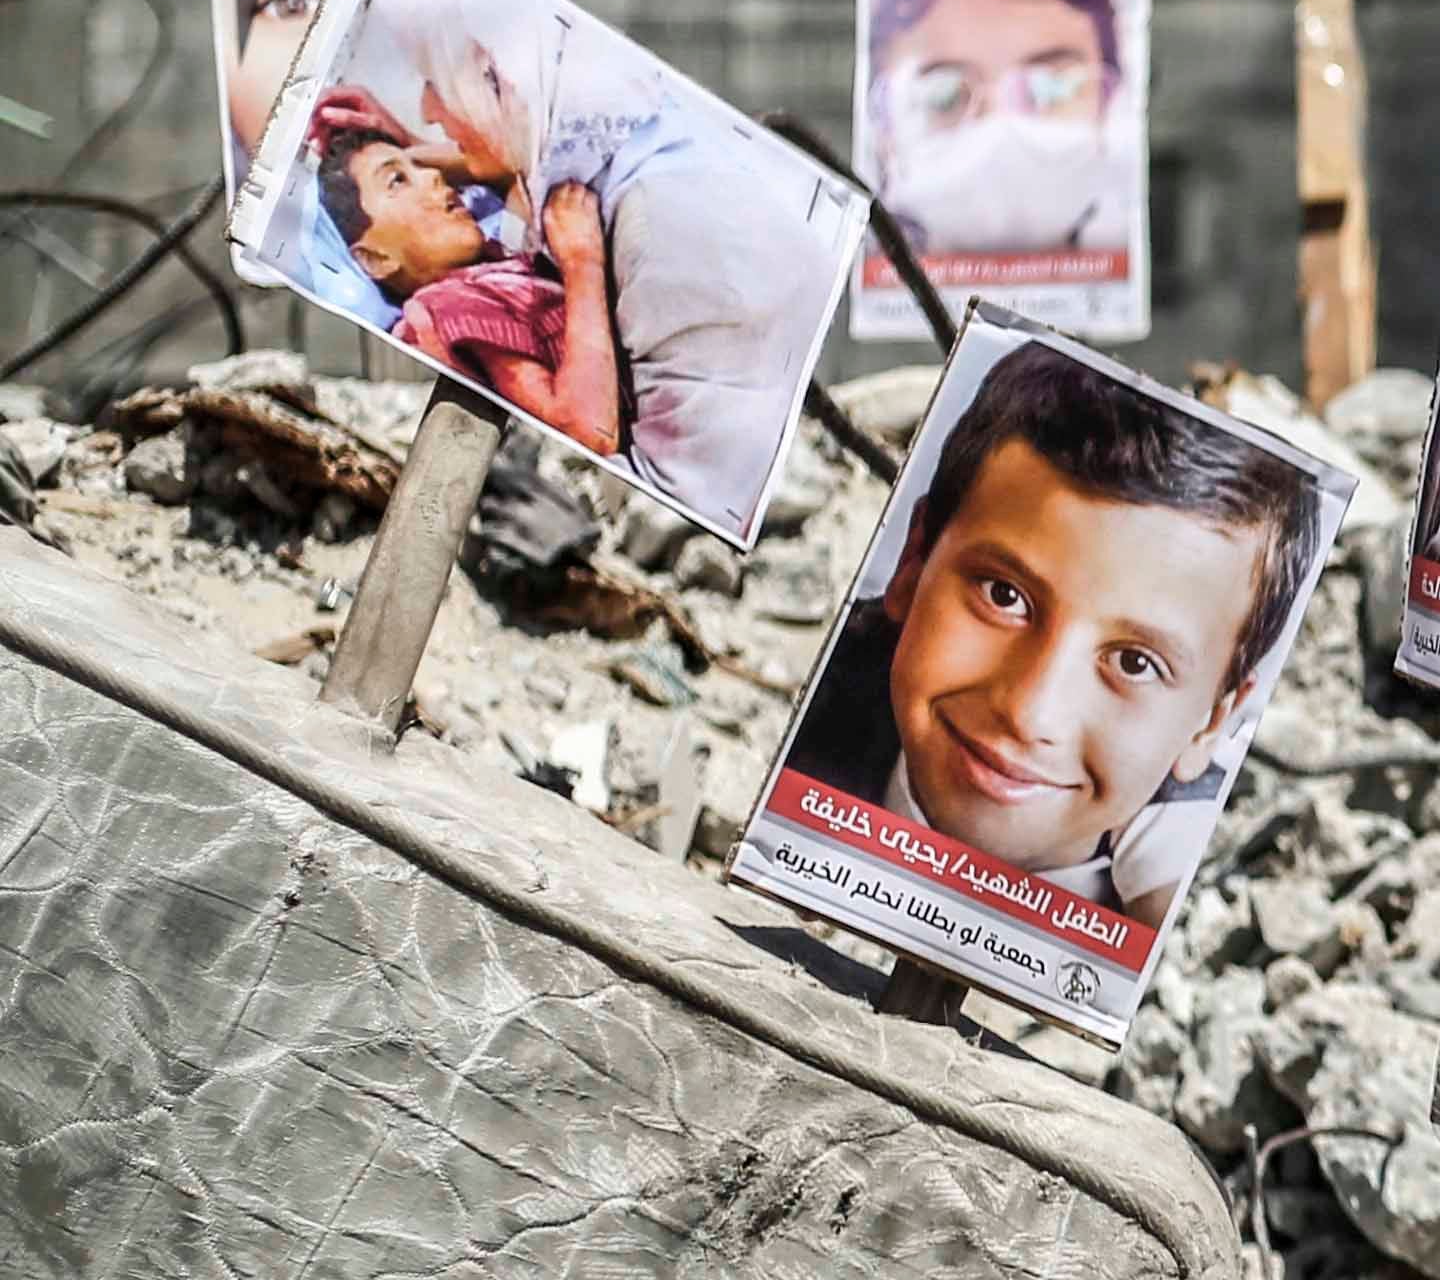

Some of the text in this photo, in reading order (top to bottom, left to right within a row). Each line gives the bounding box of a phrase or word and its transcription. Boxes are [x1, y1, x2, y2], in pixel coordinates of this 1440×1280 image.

[775, 843, 1047, 978] جمعية لو بطلنا نحلم الخيرية
[800, 788, 1128, 949] الطفل الشهيد/ يحيى خليفة
